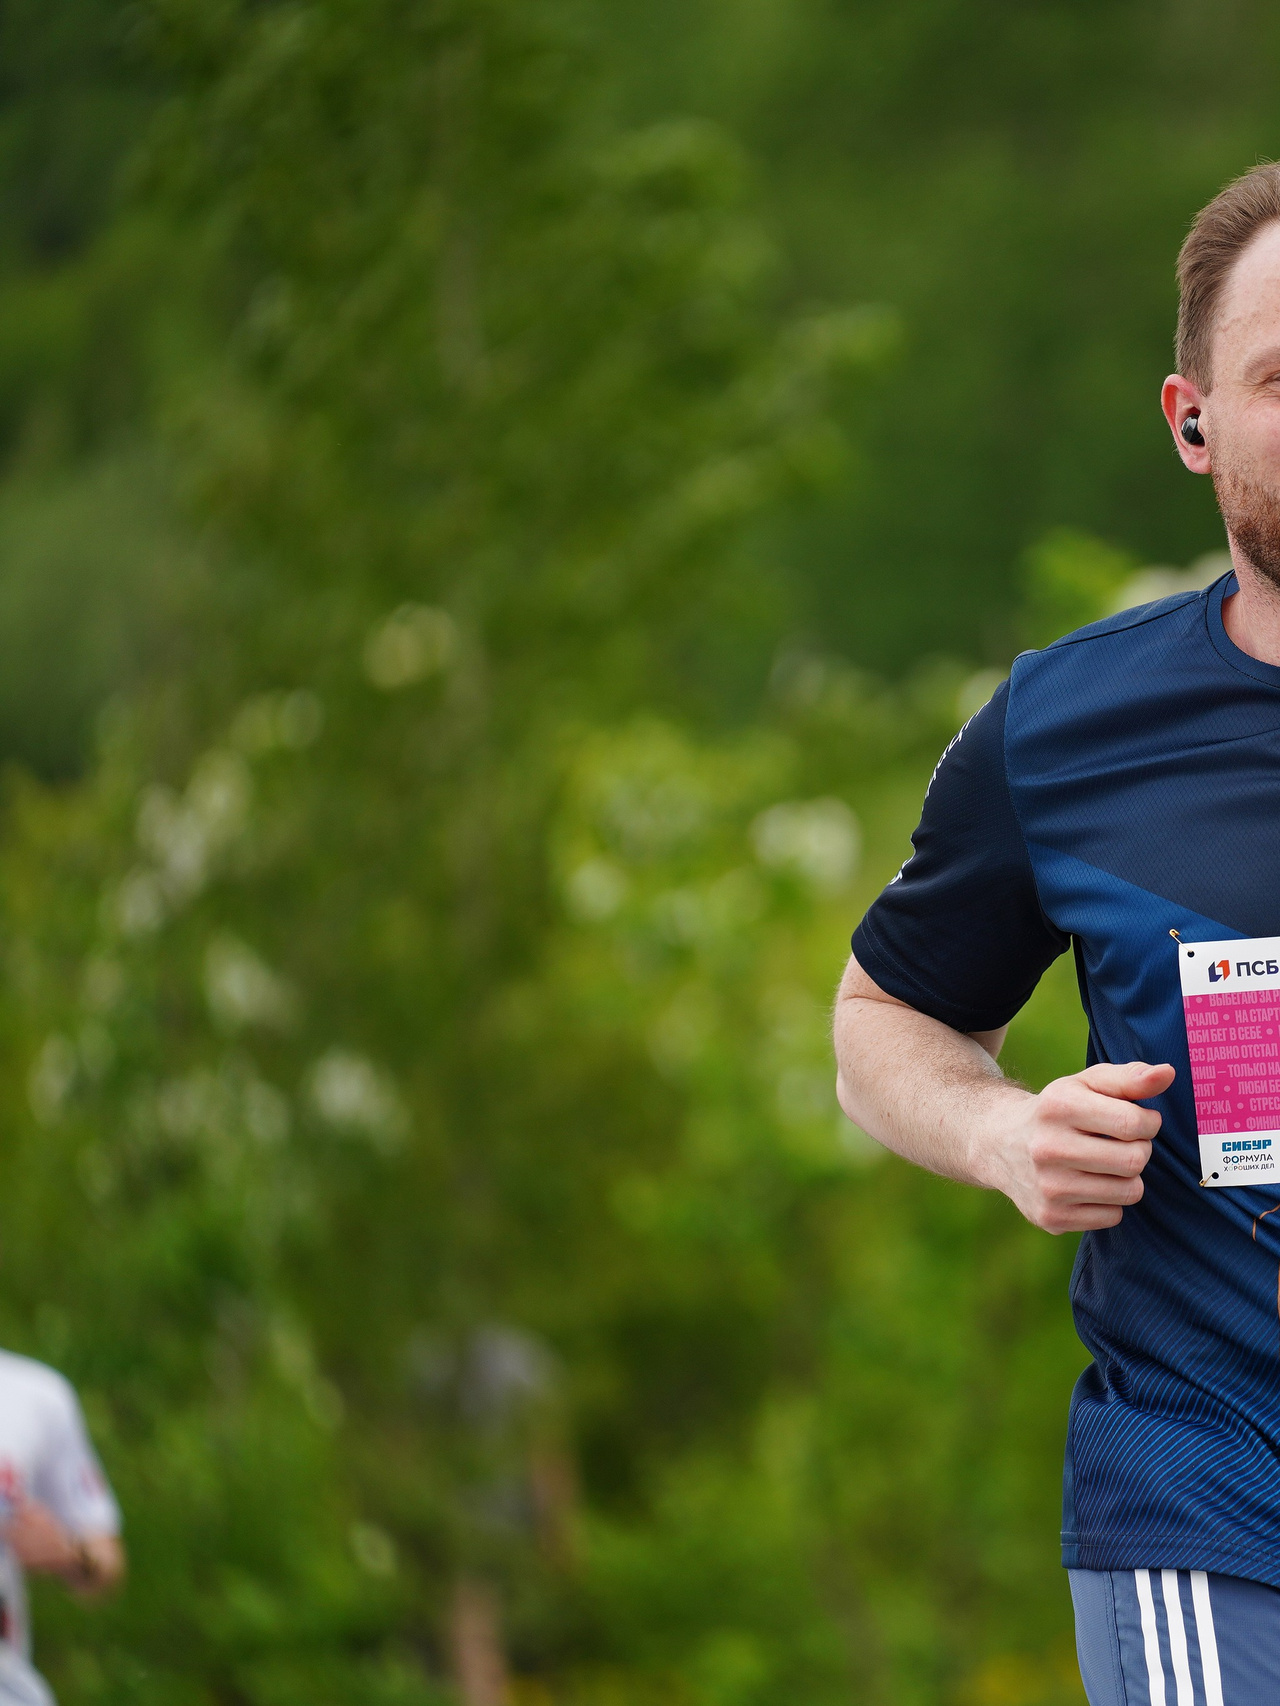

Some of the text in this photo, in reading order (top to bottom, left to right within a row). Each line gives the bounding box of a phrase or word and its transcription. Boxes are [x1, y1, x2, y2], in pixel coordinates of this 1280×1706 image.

[1236, 959, 1279, 977] ПСБ
[1209, 992, 1258, 1007] ВЫБЕГАЮ
[1259, 990, 1270, 1004] ЗА
[1235, 1009, 1249, 1024] НА
[1210, 1028, 1228, 1042] БЕГ
[1229, 1027, 1237, 1041] В
[1238, 1025, 1263, 1040] СЕБЕ
[1207, 1045, 1240, 1062] ДАВНО
[1241, 1043, 1279, 1059] ОТСТАЛ
[1228, 1062, 1267, 1078] ТОЛЬКО
[1238, 1080, 1268, 1095] ЛЮБИ
[1222, 1139, 1272, 1152] СИБУР
[1223, 1154, 1273, 1164] ФОРМУЛА
[1224, 1163, 1260, 1172] ХОРОШИХ
